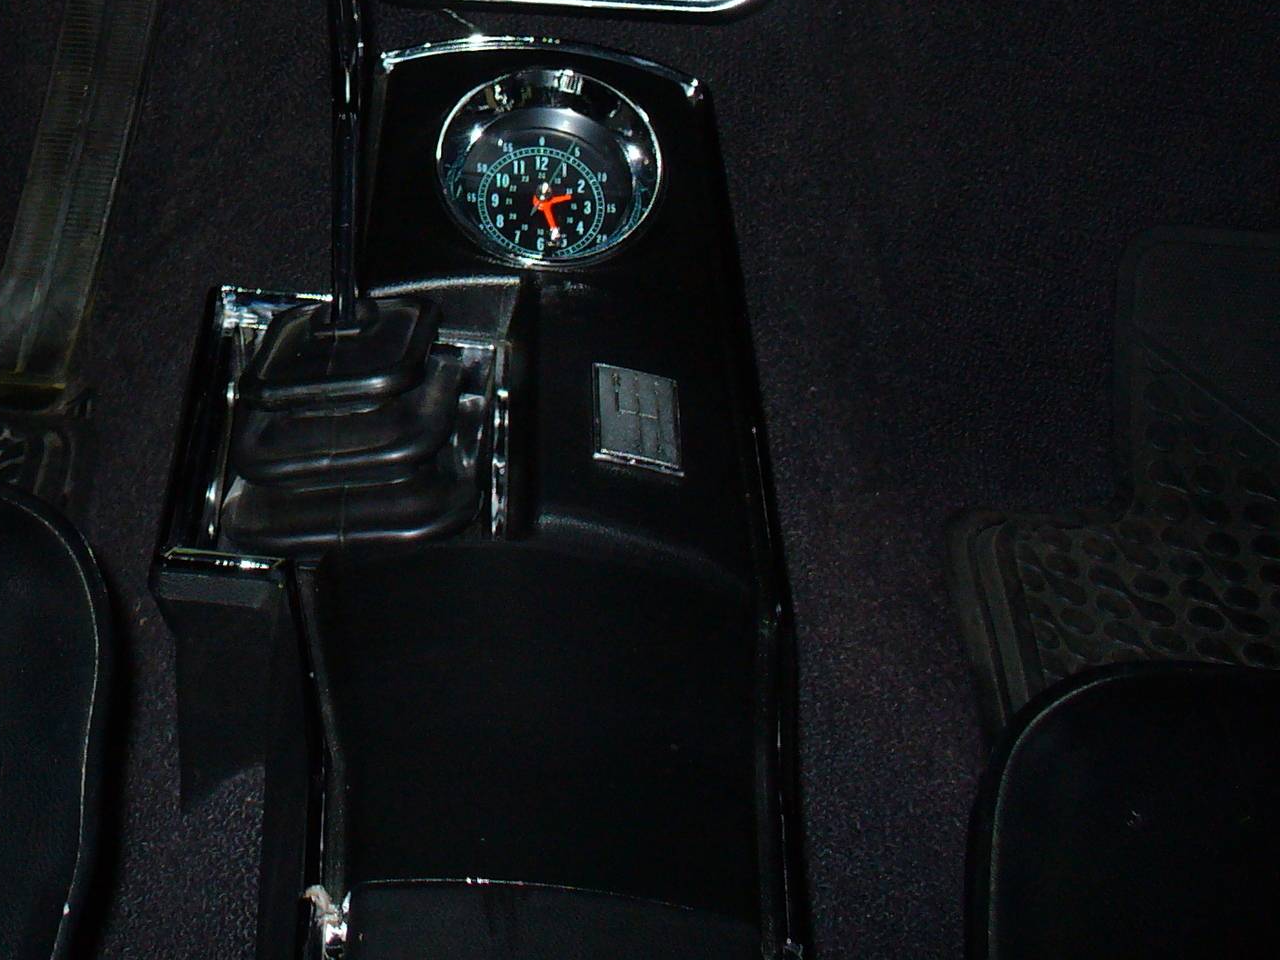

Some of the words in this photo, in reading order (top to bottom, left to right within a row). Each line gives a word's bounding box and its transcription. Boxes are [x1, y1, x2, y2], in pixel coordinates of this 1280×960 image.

[513, 160, 526, 175] 11
[535, 156, 549, 171] 12
[562, 162, 568, 178] 1
[496, 173, 510, 188] 10
[577, 178, 586, 193] 2
[491, 193, 499, 208] 9
[583, 201, 592, 215] 3
[606, 203, 616, 214] 15
[496, 214, 504, 228] 8
[576, 220, 584, 235] 4
[514, 230, 521, 244] 7
[536, 237, 545, 251] 6
